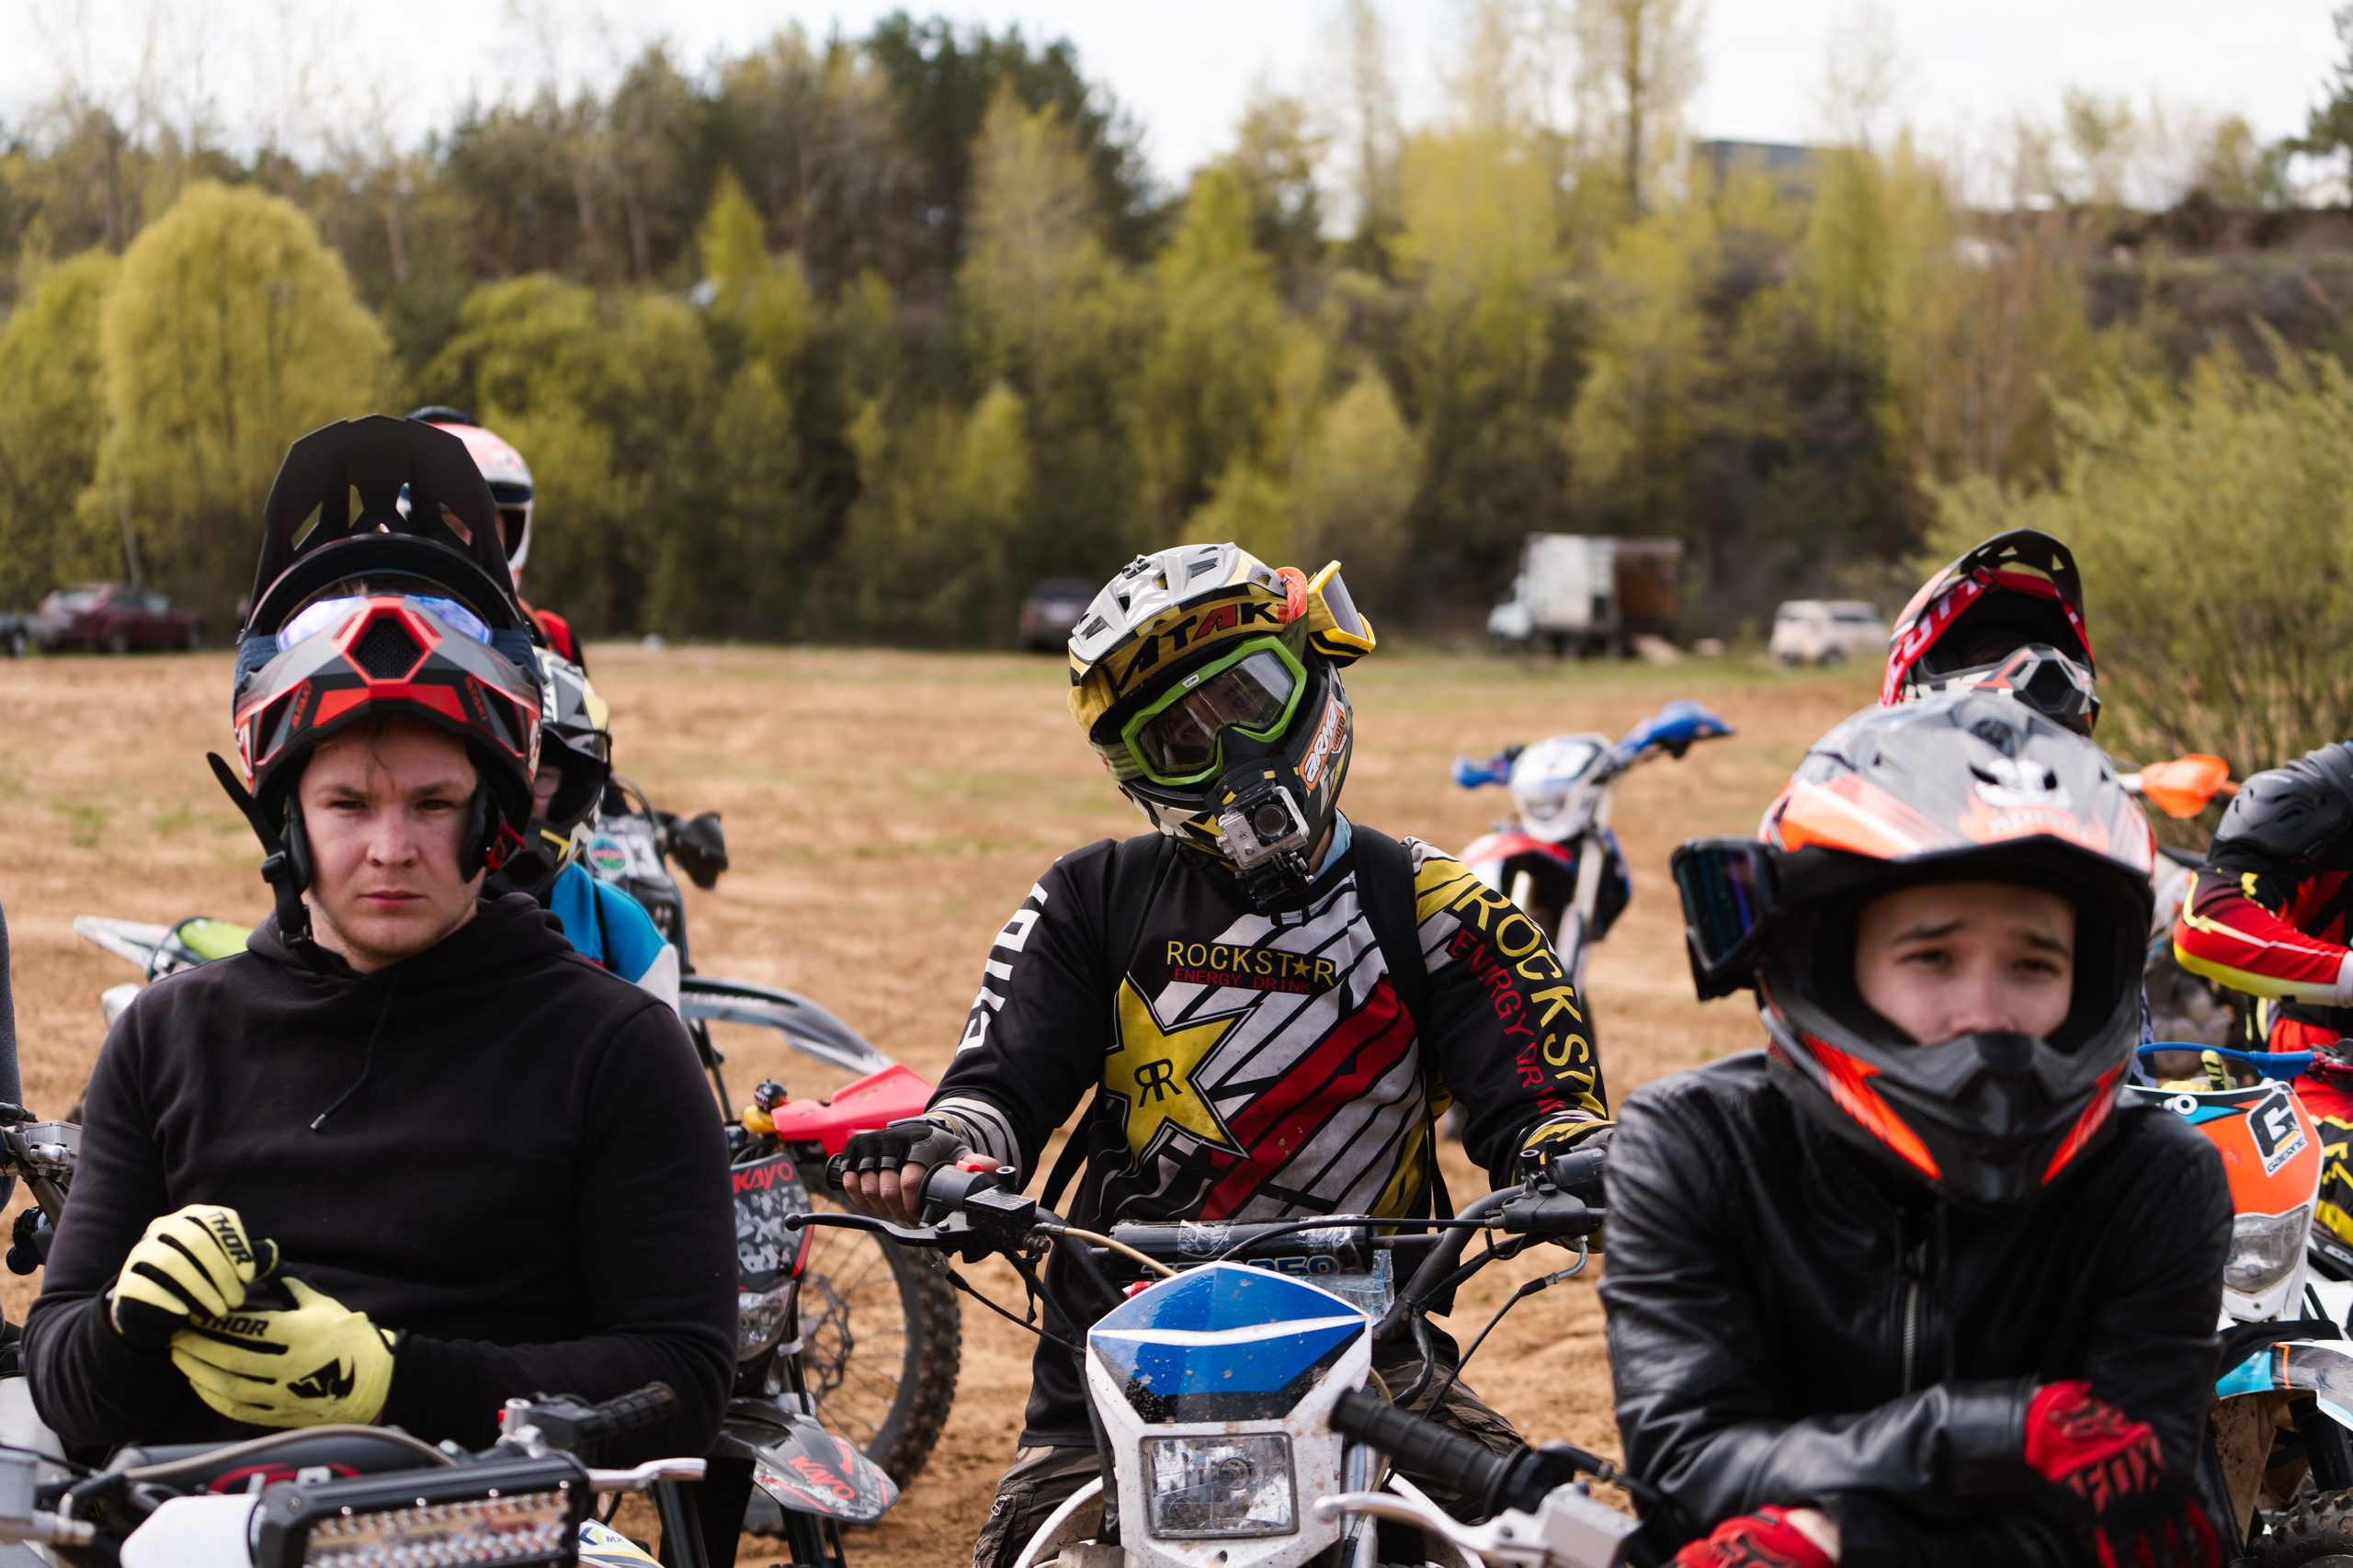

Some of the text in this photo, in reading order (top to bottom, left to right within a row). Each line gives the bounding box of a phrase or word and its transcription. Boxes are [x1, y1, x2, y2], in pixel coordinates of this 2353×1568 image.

[1174, 968, 1312, 994] ENERGY DRINK
[733, 1161, 794, 1194] KAYO
[208, 1210, 254, 1267] THOR
[788, 1456, 856, 1500] KAYO
